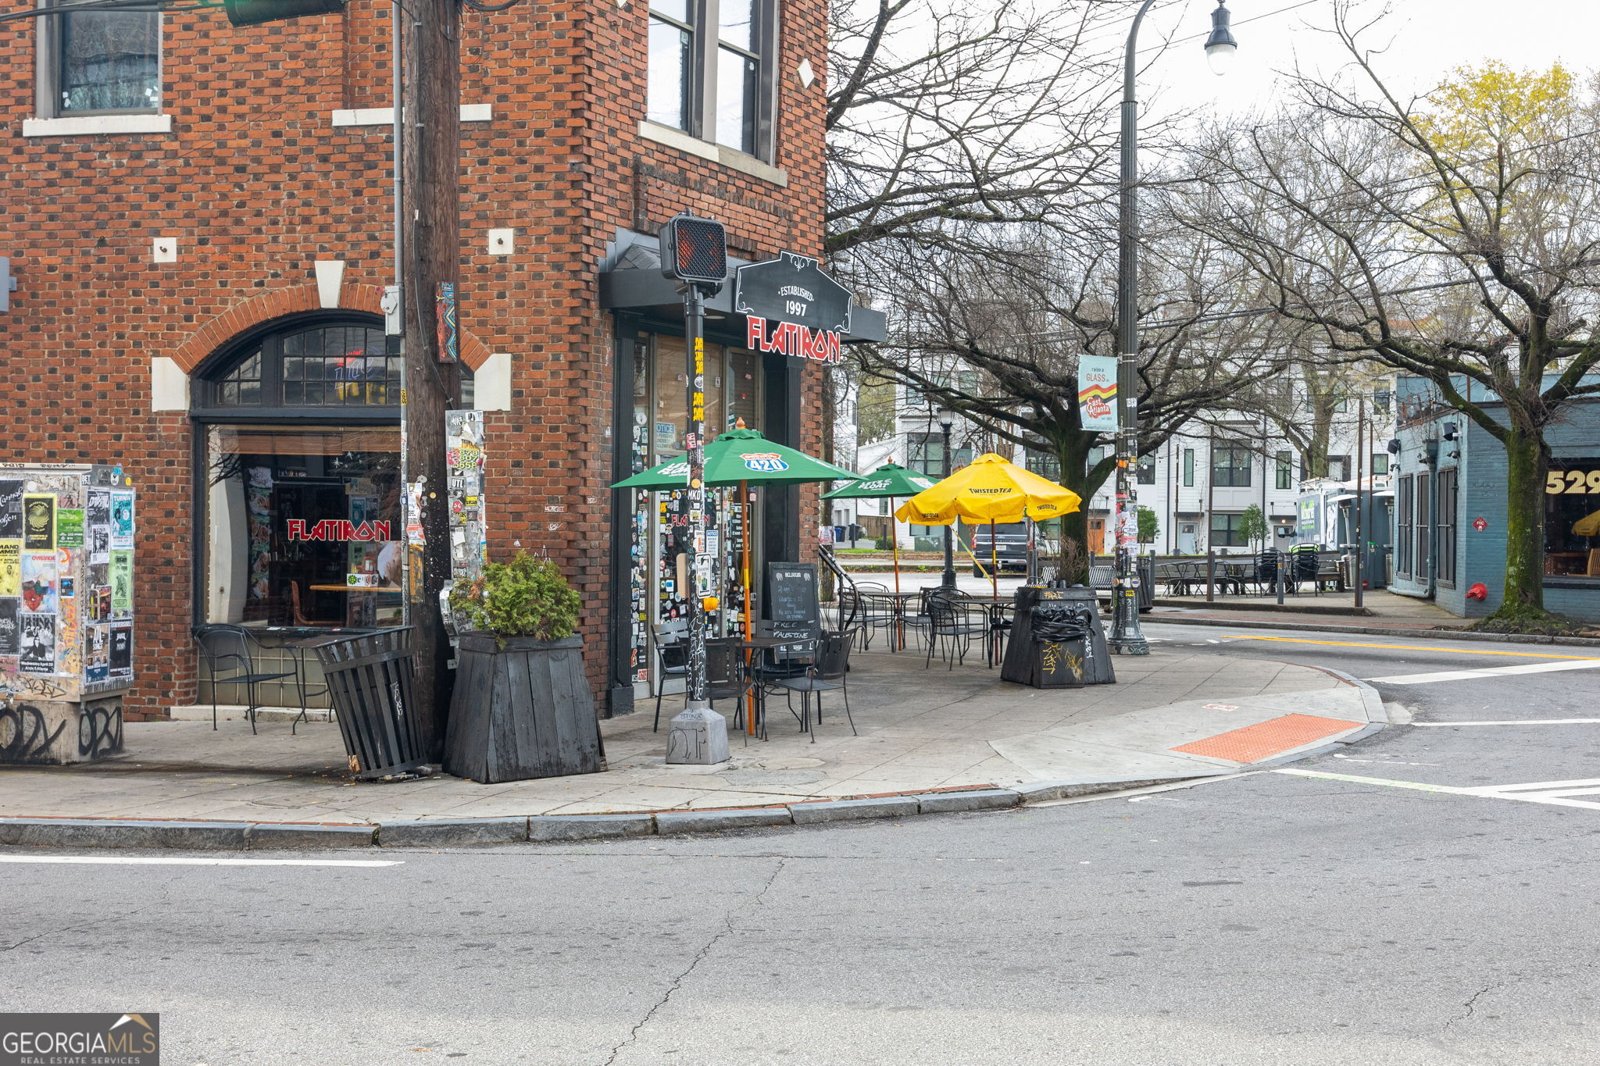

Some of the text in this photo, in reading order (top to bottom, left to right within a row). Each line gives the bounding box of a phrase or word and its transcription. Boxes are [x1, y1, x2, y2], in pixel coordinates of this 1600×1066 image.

[780, 285, 814, 301] ESTABLISHED
[786, 300, 807, 317] 1997
[746, 314, 841, 364] FLATIRON
[1086, 373, 1106, 382] GLASS
[750, 459, 784, 470] 420
[1545, 470, 1600, 494] 529
[286, 518, 391, 542] FLATIRON
